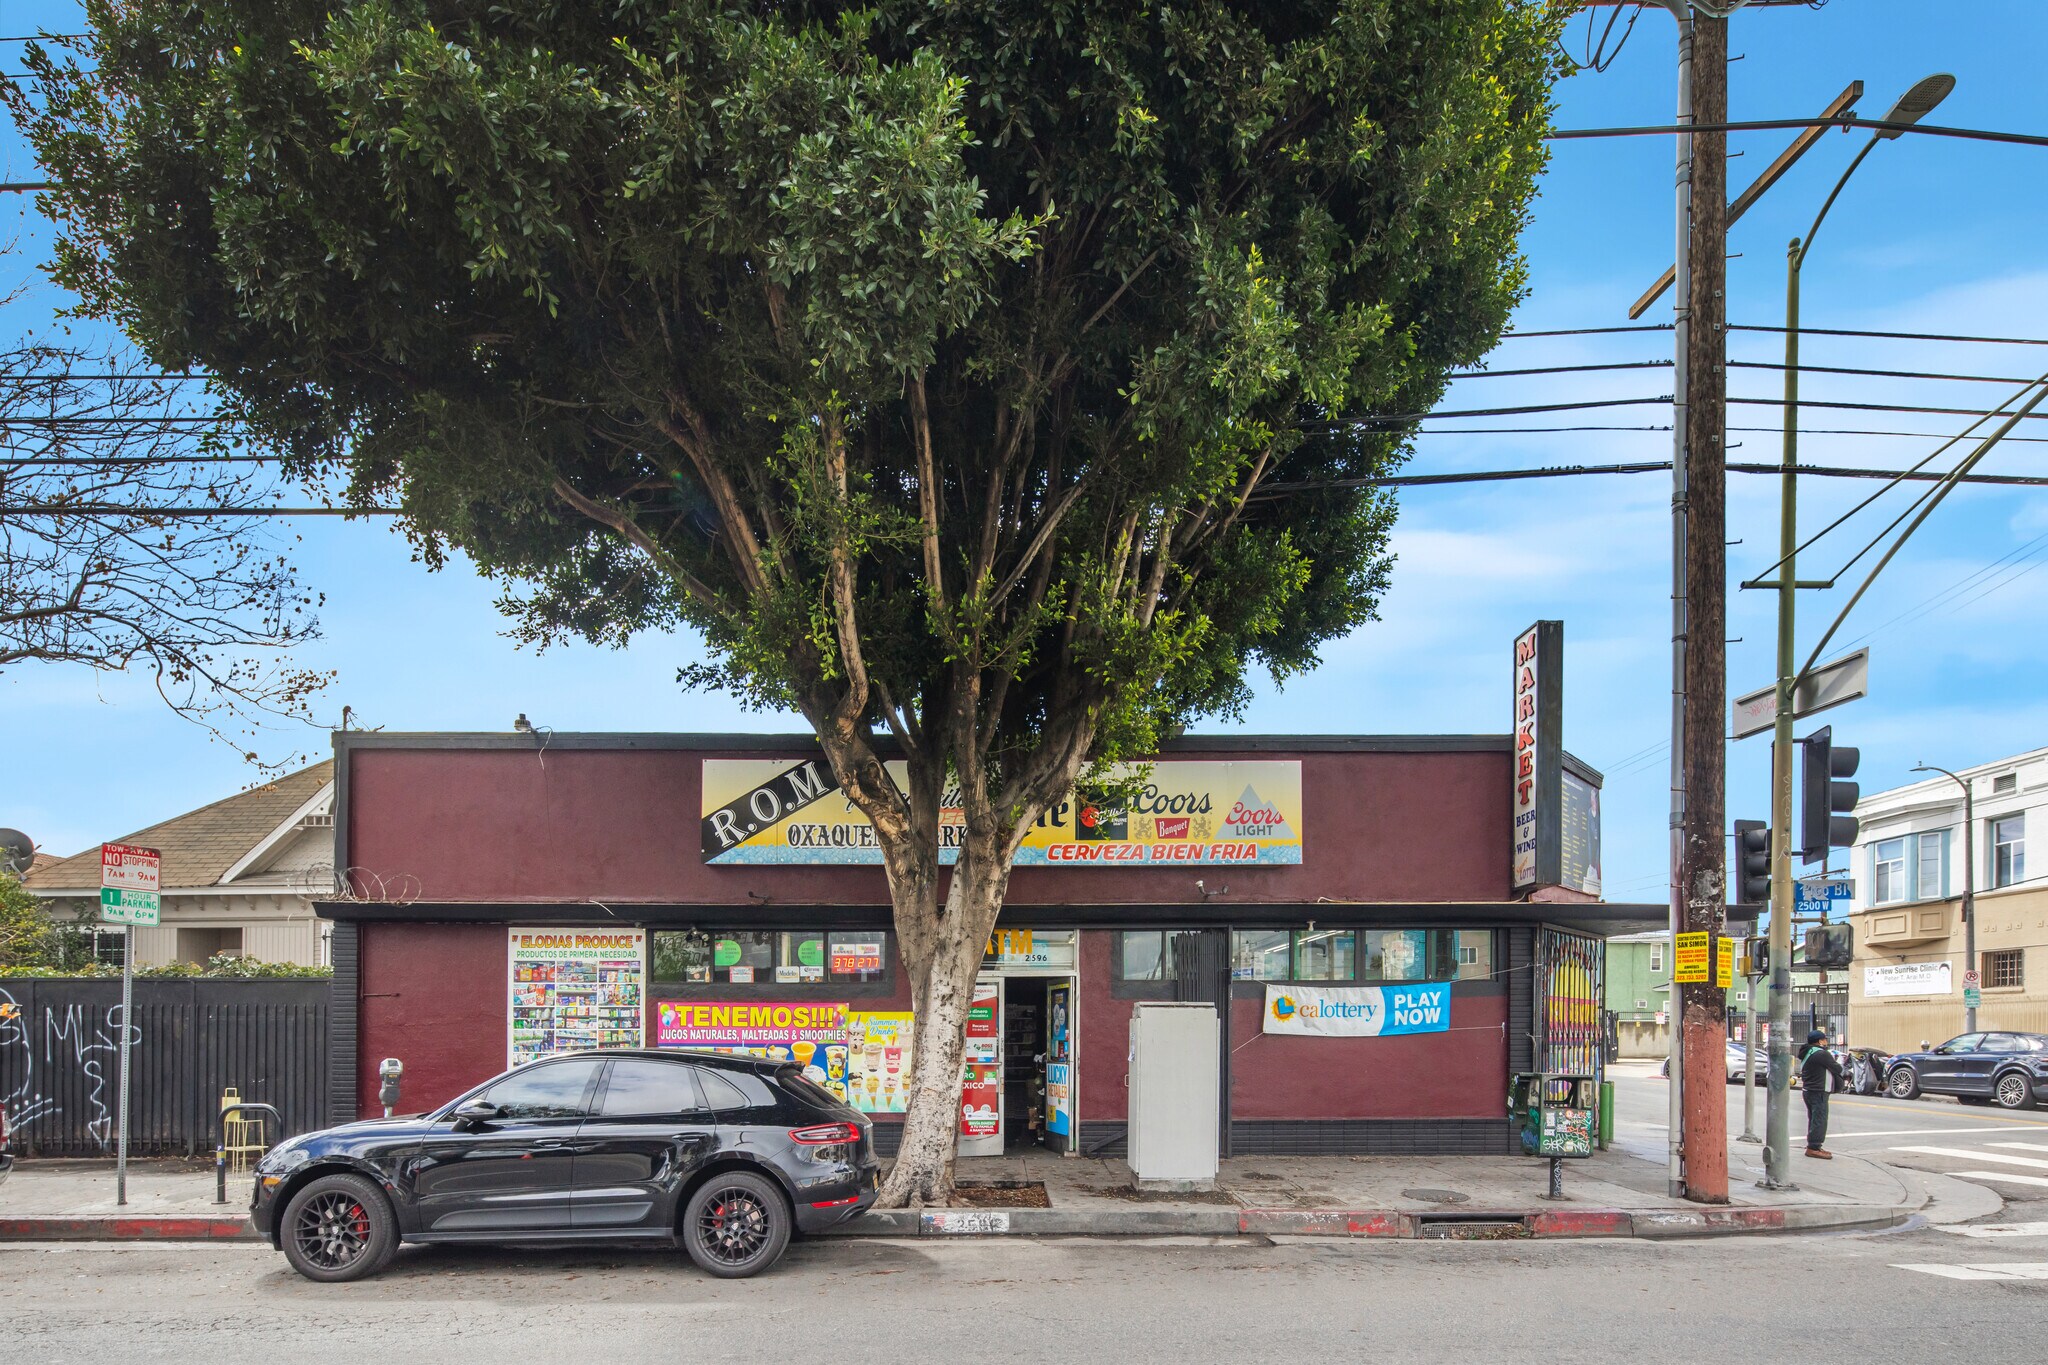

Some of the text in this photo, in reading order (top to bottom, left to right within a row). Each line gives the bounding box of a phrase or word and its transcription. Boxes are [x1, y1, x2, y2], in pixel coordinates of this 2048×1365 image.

[1517, 633, 1536, 805] MARKET
[1132, 783, 1213, 815] Coors
[1225, 801, 1285, 826] Coors
[1516, 809, 1536, 828] BEER
[1158, 819, 1188, 839] Banquet
[1235, 824, 1274, 837] LIGHT
[1047, 843, 1258, 861] CERVEZA BIEN FRIA
[1516, 838, 1537, 855] WINE
[104, 852, 158, 869] NO STOPPING
[109, 891, 113, 903] 1
[127, 892, 152, 900] HOUR
[121, 898, 157, 911] PARKING
[1797, 901, 1830, 911] 2500 W
[520, 935, 634, 949] ELODIAS PRODUCE
[1689, 940, 1707, 948] SIMON
[516, 950, 638, 959] PRODUCTOS DE PRIMERA NECESIDAD
[1025, 954, 1048, 962] 2596
[833, 957, 855, 968] 378
[857, 957, 879, 968] 277
[1880, 963, 1939, 976] New Sunrise Clinic
[1394, 991, 1442, 1009] PLAY
[675, 1006, 835, 1028] TENEMOS!!!
[1299, 998, 1378, 1022] calottery
[1394, 1008, 1442, 1026] NOW
[867, 1016, 898, 1026] Summer
[660, 1029, 847, 1042] JUGOS NATURALES, MALTEADAS & SMOOTHIES
[869, 1026, 895, 1037] Drinks
[1047, 1064, 1068, 1084] LUCKY
[1047, 1083, 1068, 1098] RETAILER
